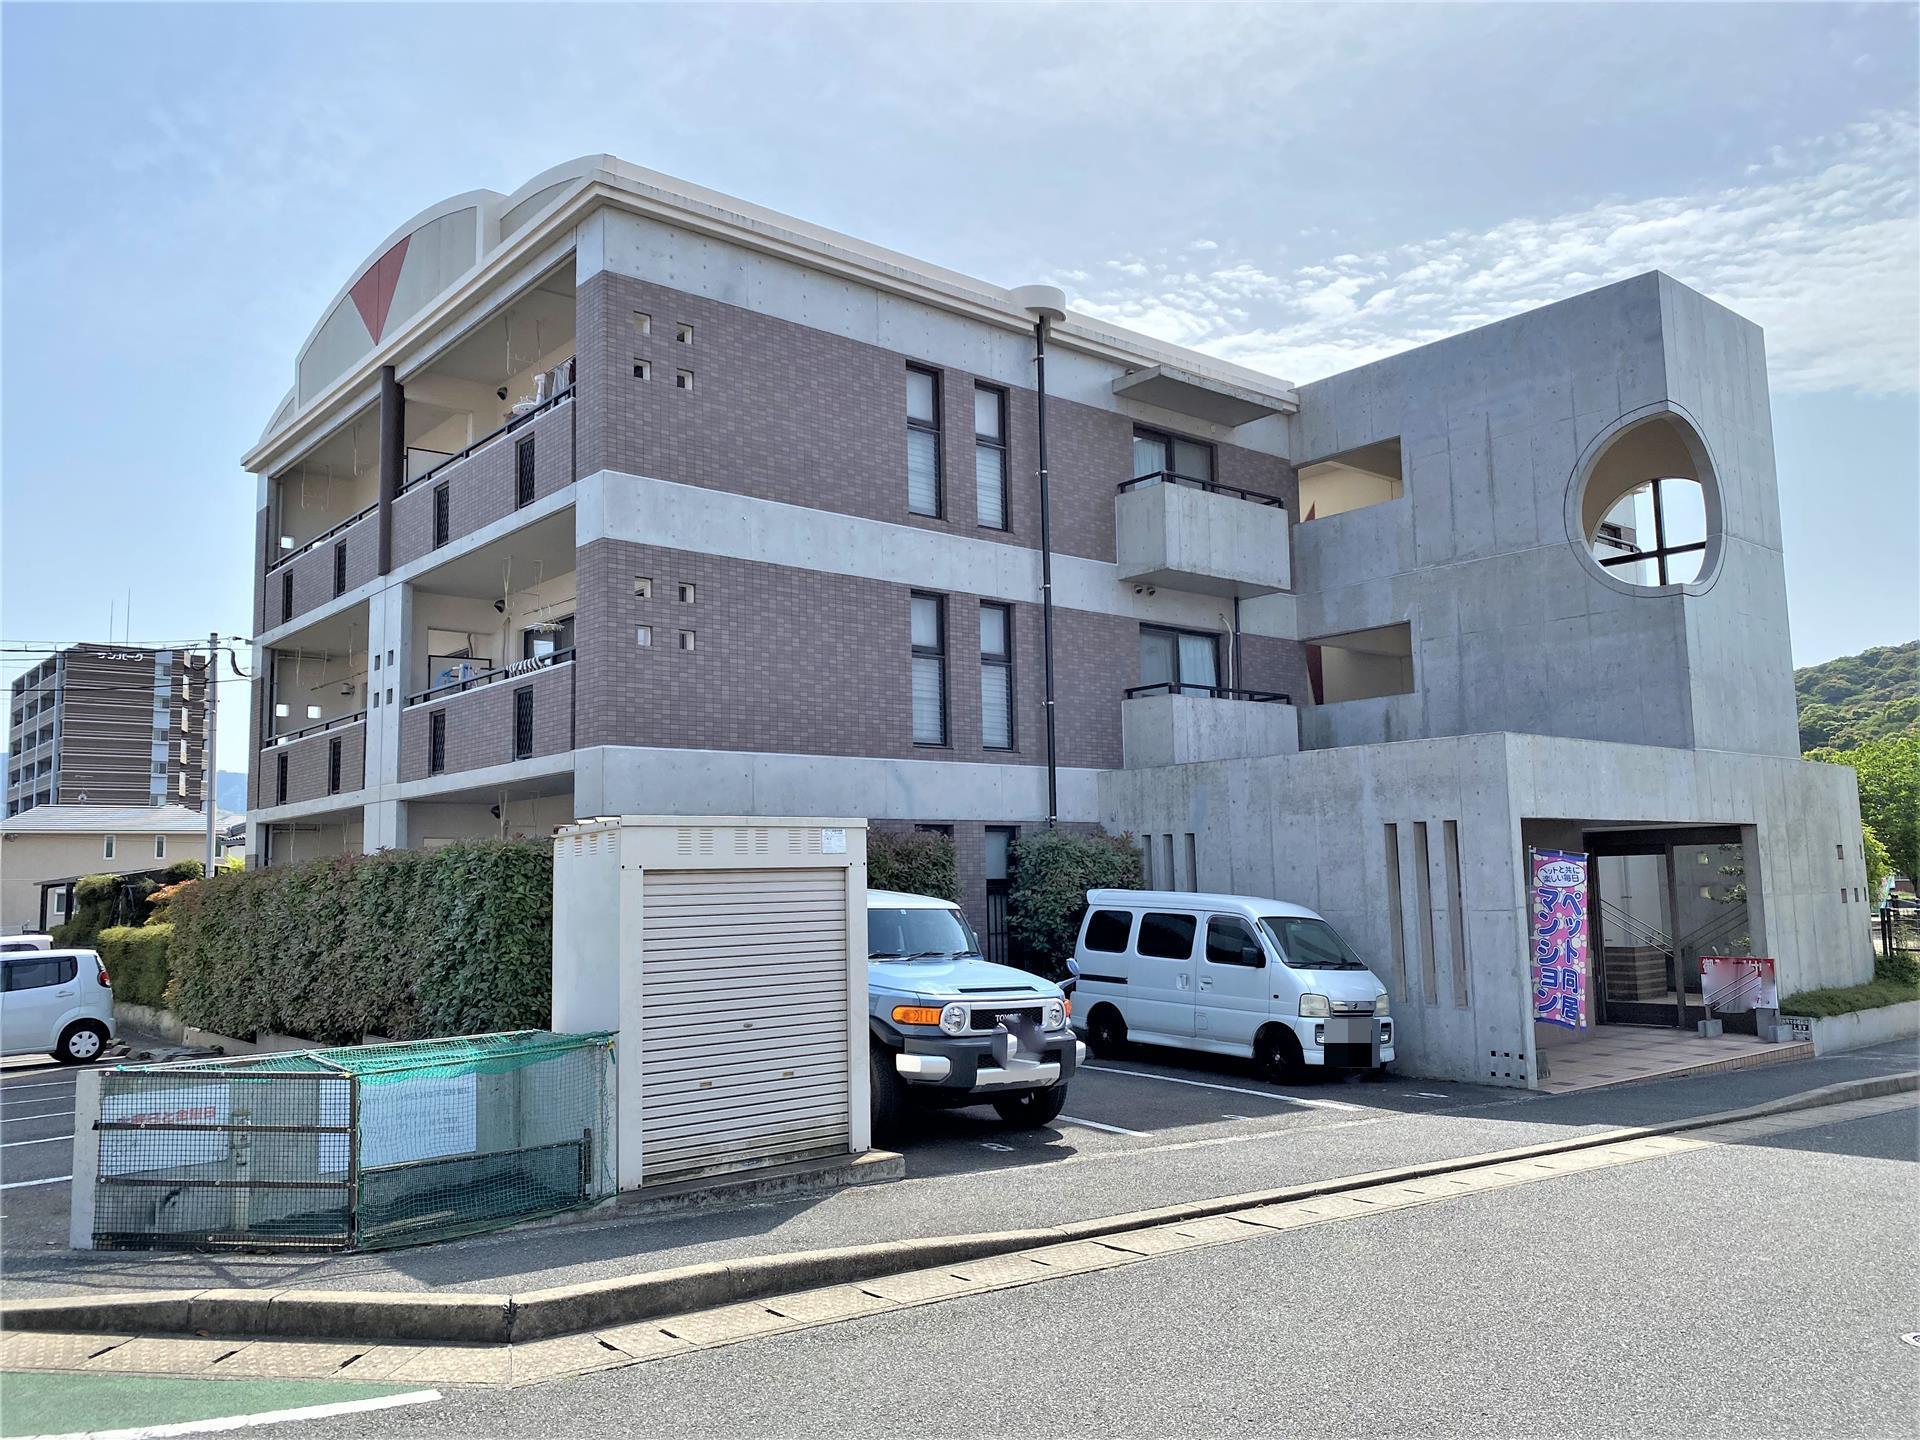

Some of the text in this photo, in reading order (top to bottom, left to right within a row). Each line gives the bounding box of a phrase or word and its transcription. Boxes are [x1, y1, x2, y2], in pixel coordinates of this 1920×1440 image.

[1540, 866, 1581, 875] ペットと共に
[1543, 874, 1580, 883] 楽しい毎日
[1537, 887, 1560, 1013] マンション
[1561, 892, 1583, 1021] ペット同居
[995, 1013, 1021, 1023] TOY
